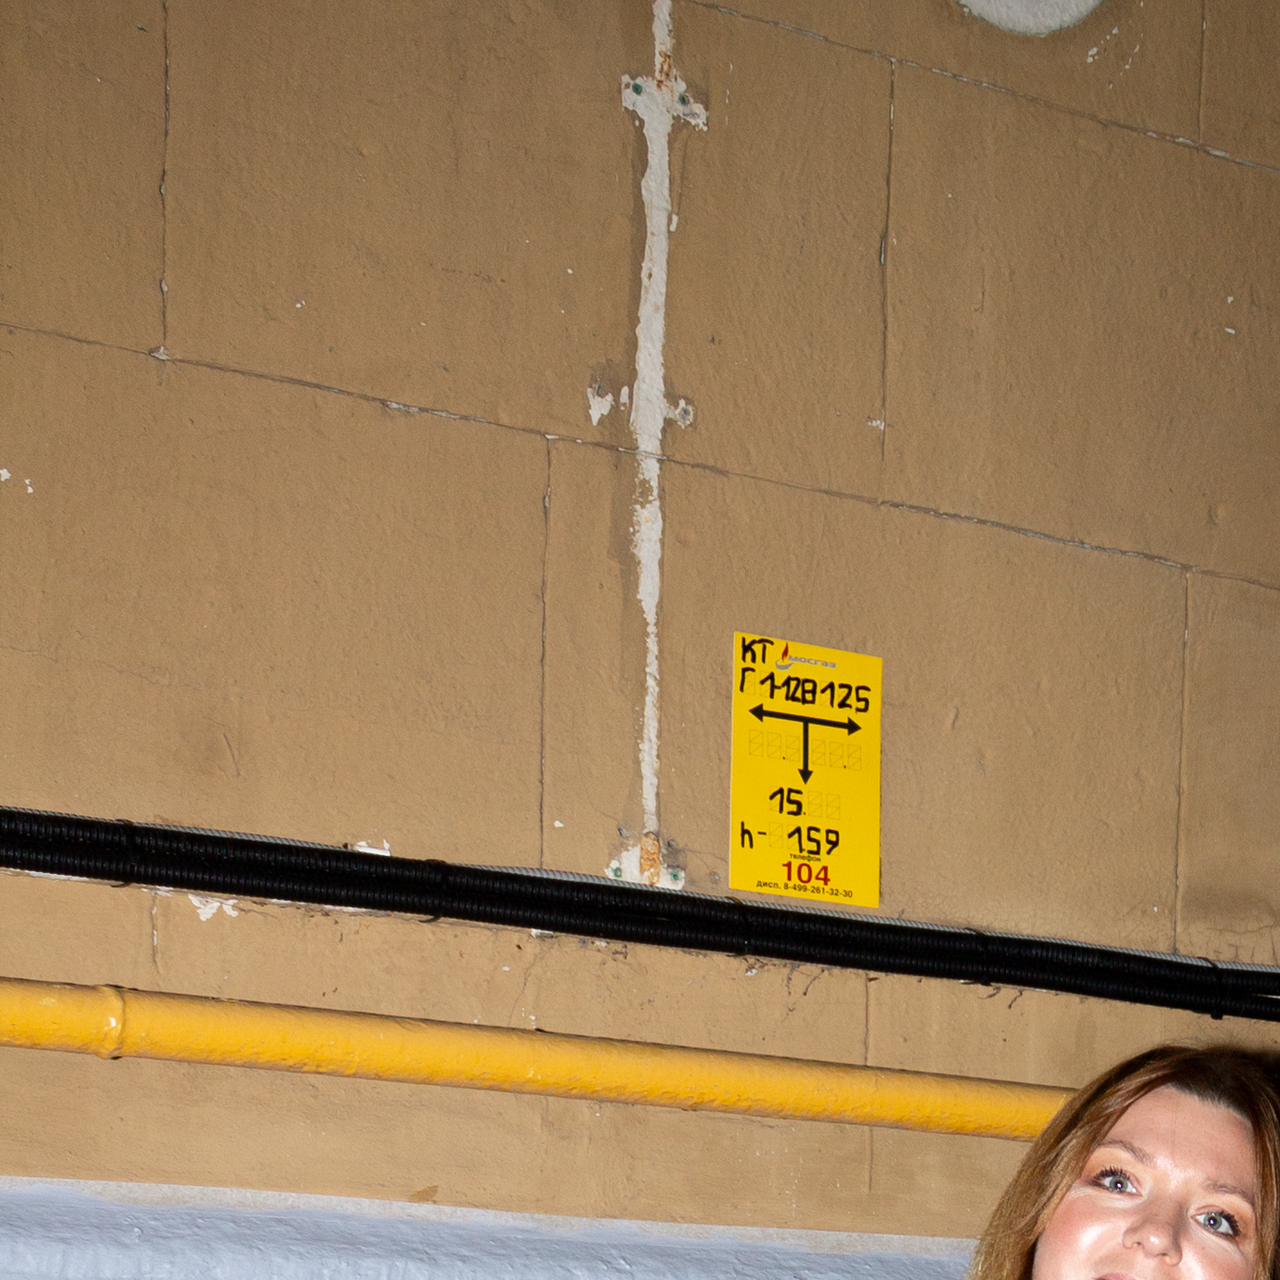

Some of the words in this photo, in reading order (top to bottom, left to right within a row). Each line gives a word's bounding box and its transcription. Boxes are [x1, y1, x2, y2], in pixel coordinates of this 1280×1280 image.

[820, 681, 871, 713] 125
[782, 861, 830, 886] 104
[784, 882, 853, 898] 8-499-261-32-30
